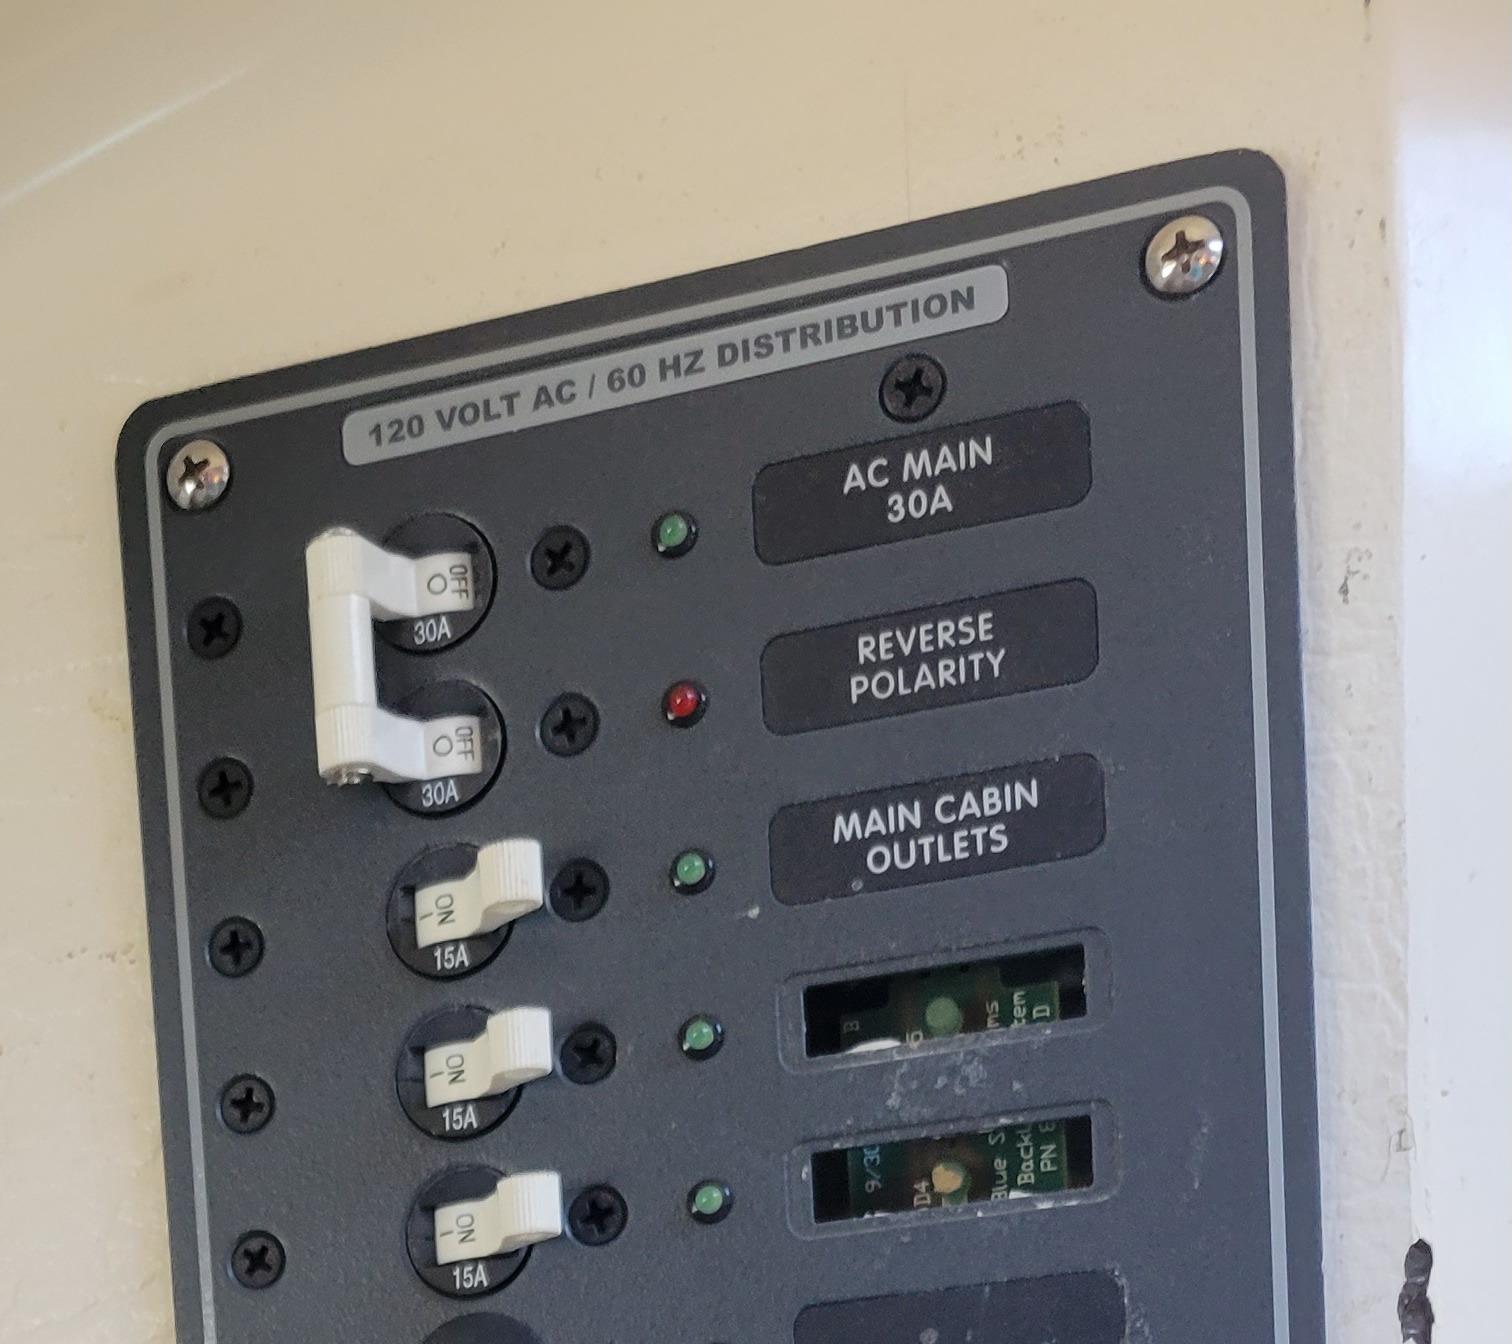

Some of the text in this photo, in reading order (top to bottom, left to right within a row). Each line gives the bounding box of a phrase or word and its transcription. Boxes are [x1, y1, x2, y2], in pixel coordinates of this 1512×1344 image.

[367, 285, 977, 448] 120 VOLT AC / 60 HZ DISTRIBUTION
[842, 435, 994, 495] AC MAIN
[887, 484, 953, 524] 30A
[449, 564, 470, 600] OFF
[414, 615, 451, 645] 30A
[857, 611, 994, 665] REVERSE
[849, 648, 1006, 705] POLARITY
[455, 726, 475, 761] OFF
[422, 779, 459, 808] 30A
[832, 778, 1040, 845] MAIN CABIN
[866, 824, 1009, 876] OUTLETS
[435, 893, 454, 926] ON
[432, 944, 470, 971] 15A
[445, 1053, 465, 1085] ON
[441, 1104, 478, 1132] 15A
[456, 1213, 475, 1244] ON
[451, 1263, 488, 1291] 15A
